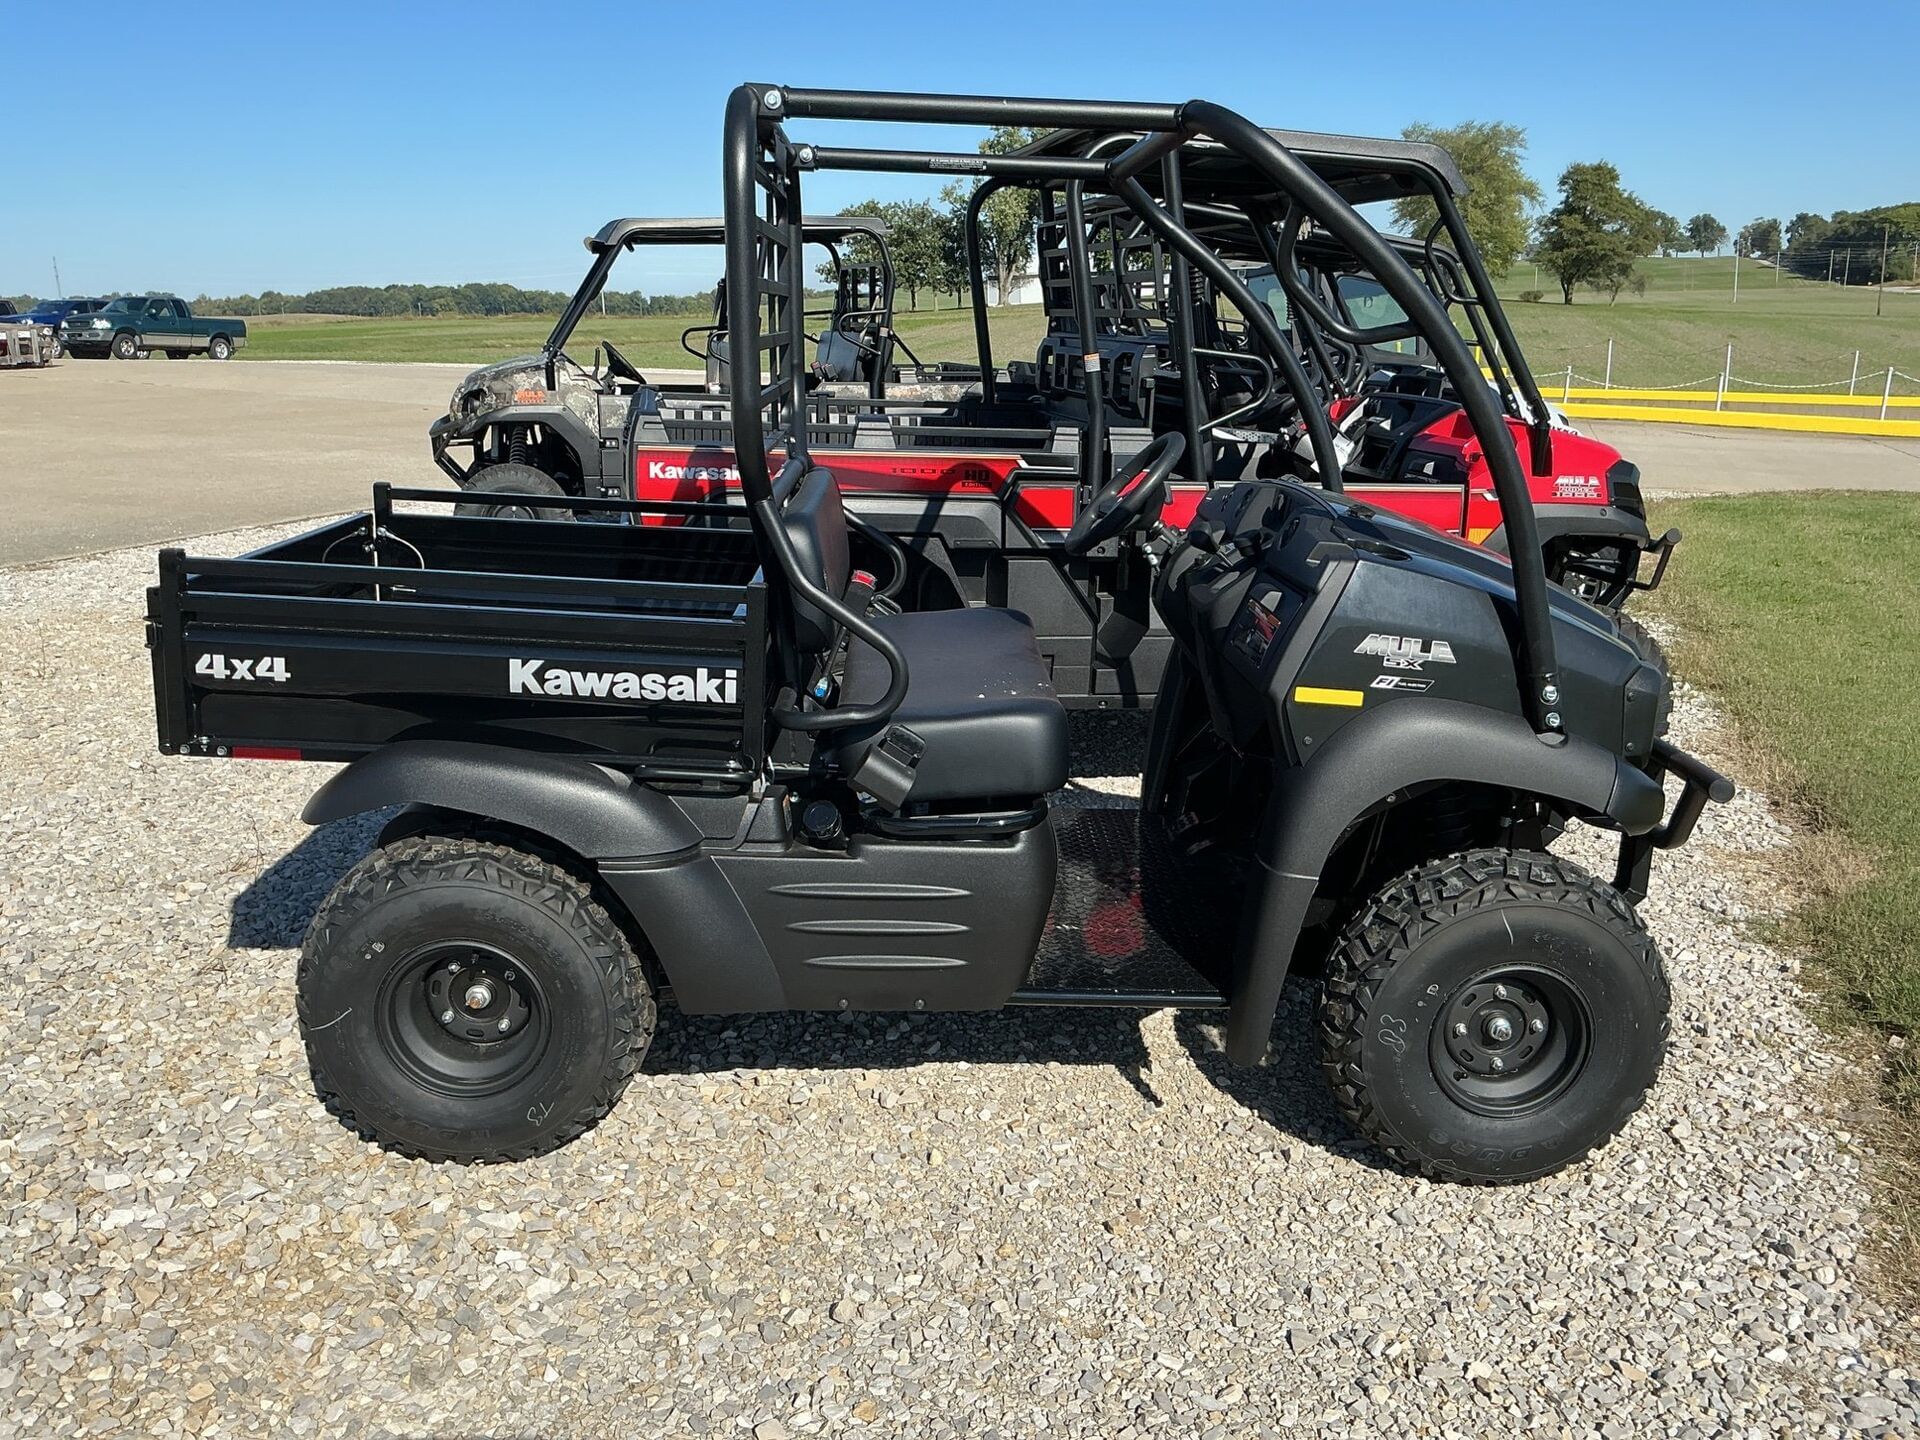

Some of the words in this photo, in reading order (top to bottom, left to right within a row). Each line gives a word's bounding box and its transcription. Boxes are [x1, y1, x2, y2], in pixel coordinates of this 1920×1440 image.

[649, 461, 742, 480] Kawasak
[1553, 475, 1602, 487] MULE
[1353, 633, 1457, 664] MULE
[195, 653, 292, 682] 4x4
[1383, 657, 1424, 671] SX
[509, 658, 738, 704] Kawasaki
